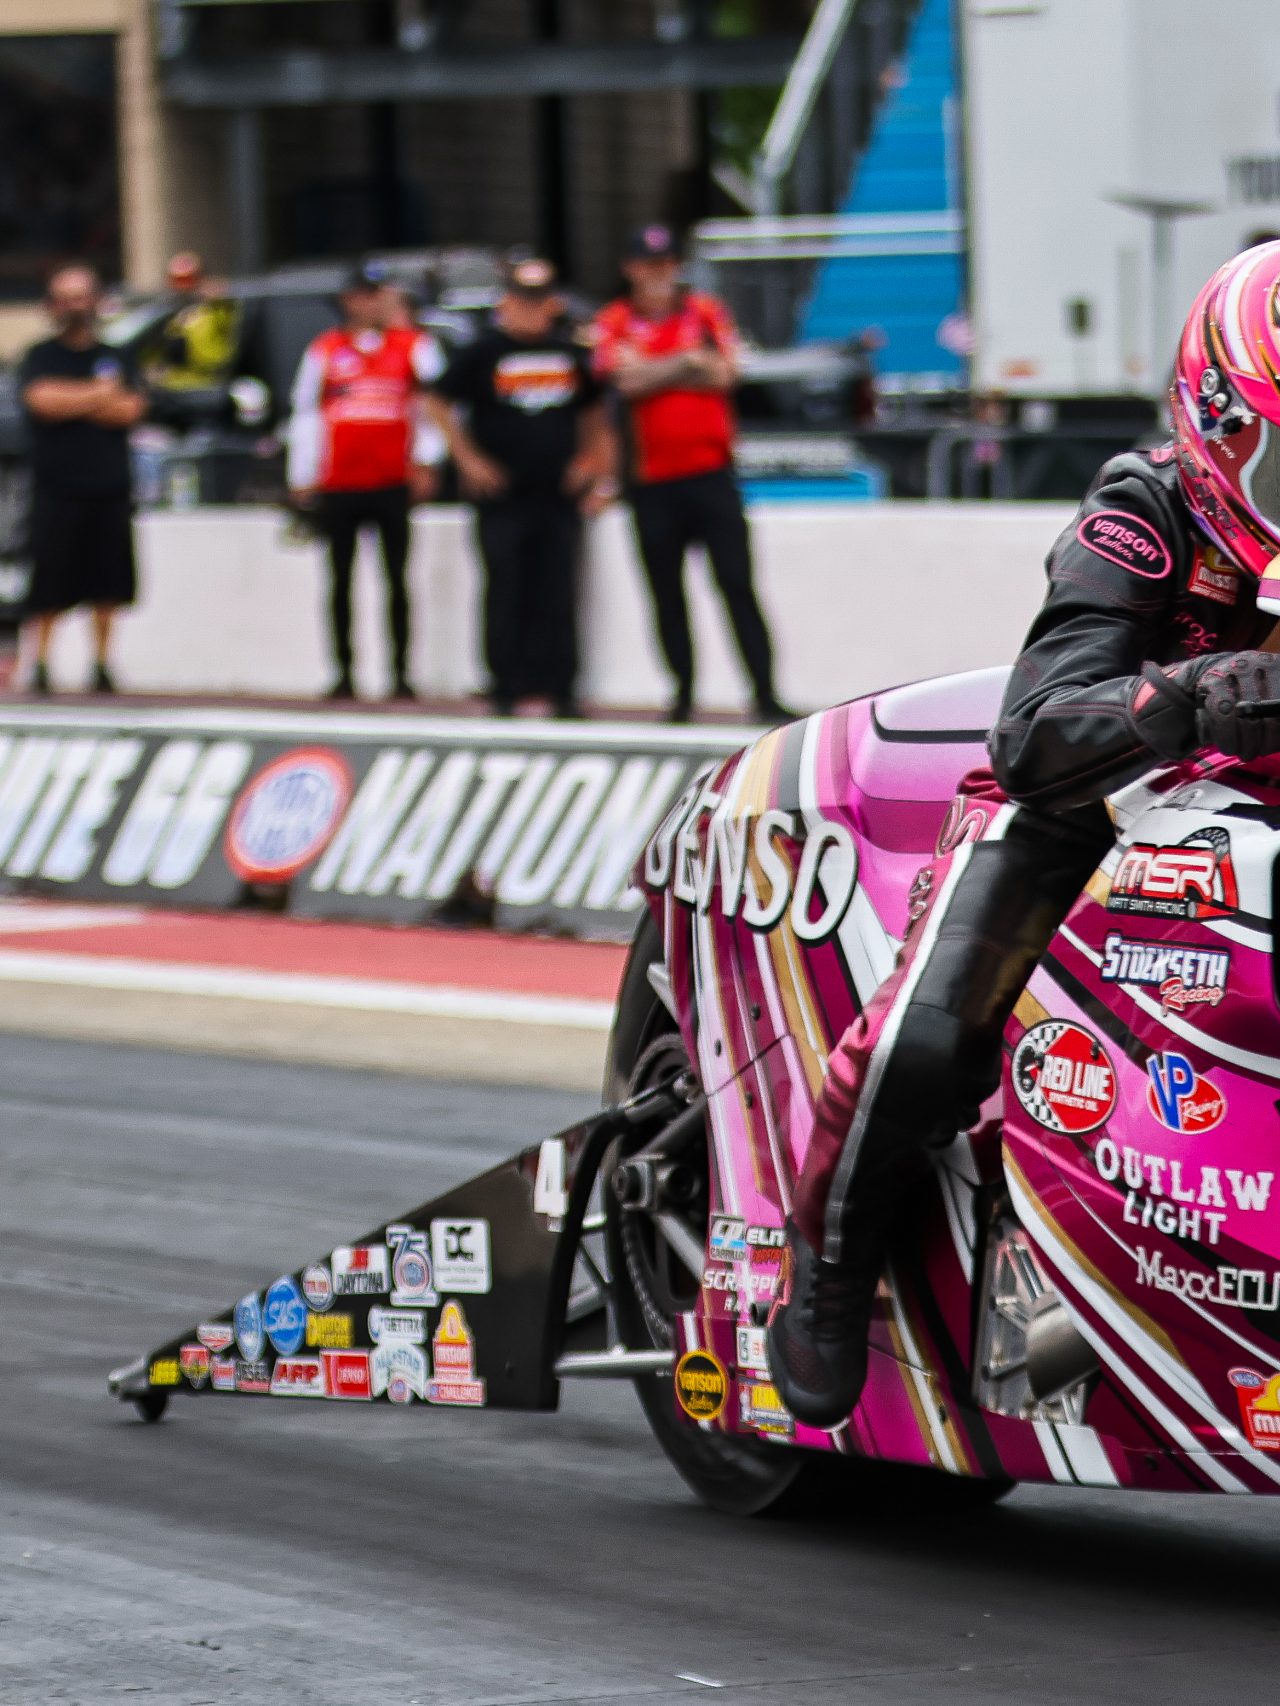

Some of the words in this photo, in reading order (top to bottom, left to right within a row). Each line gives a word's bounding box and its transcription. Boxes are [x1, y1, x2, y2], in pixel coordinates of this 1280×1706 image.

[1112, 849, 1215, 901] MSR
[1129, 898, 1153, 912] SMITH
[1153, 901, 1186, 916] RACING
[1040, 1054, 1073, 1093] RED
[1072, 1061, 1112, 1102] LINE
[1146, 1051, 1195, 1131] VP
[1095, 1138, 1275, 1212] OUTLAW
[1122, 1190, 1228, 1245] LIGHT
[336, 1271, 384, 1294] DAYTONA
